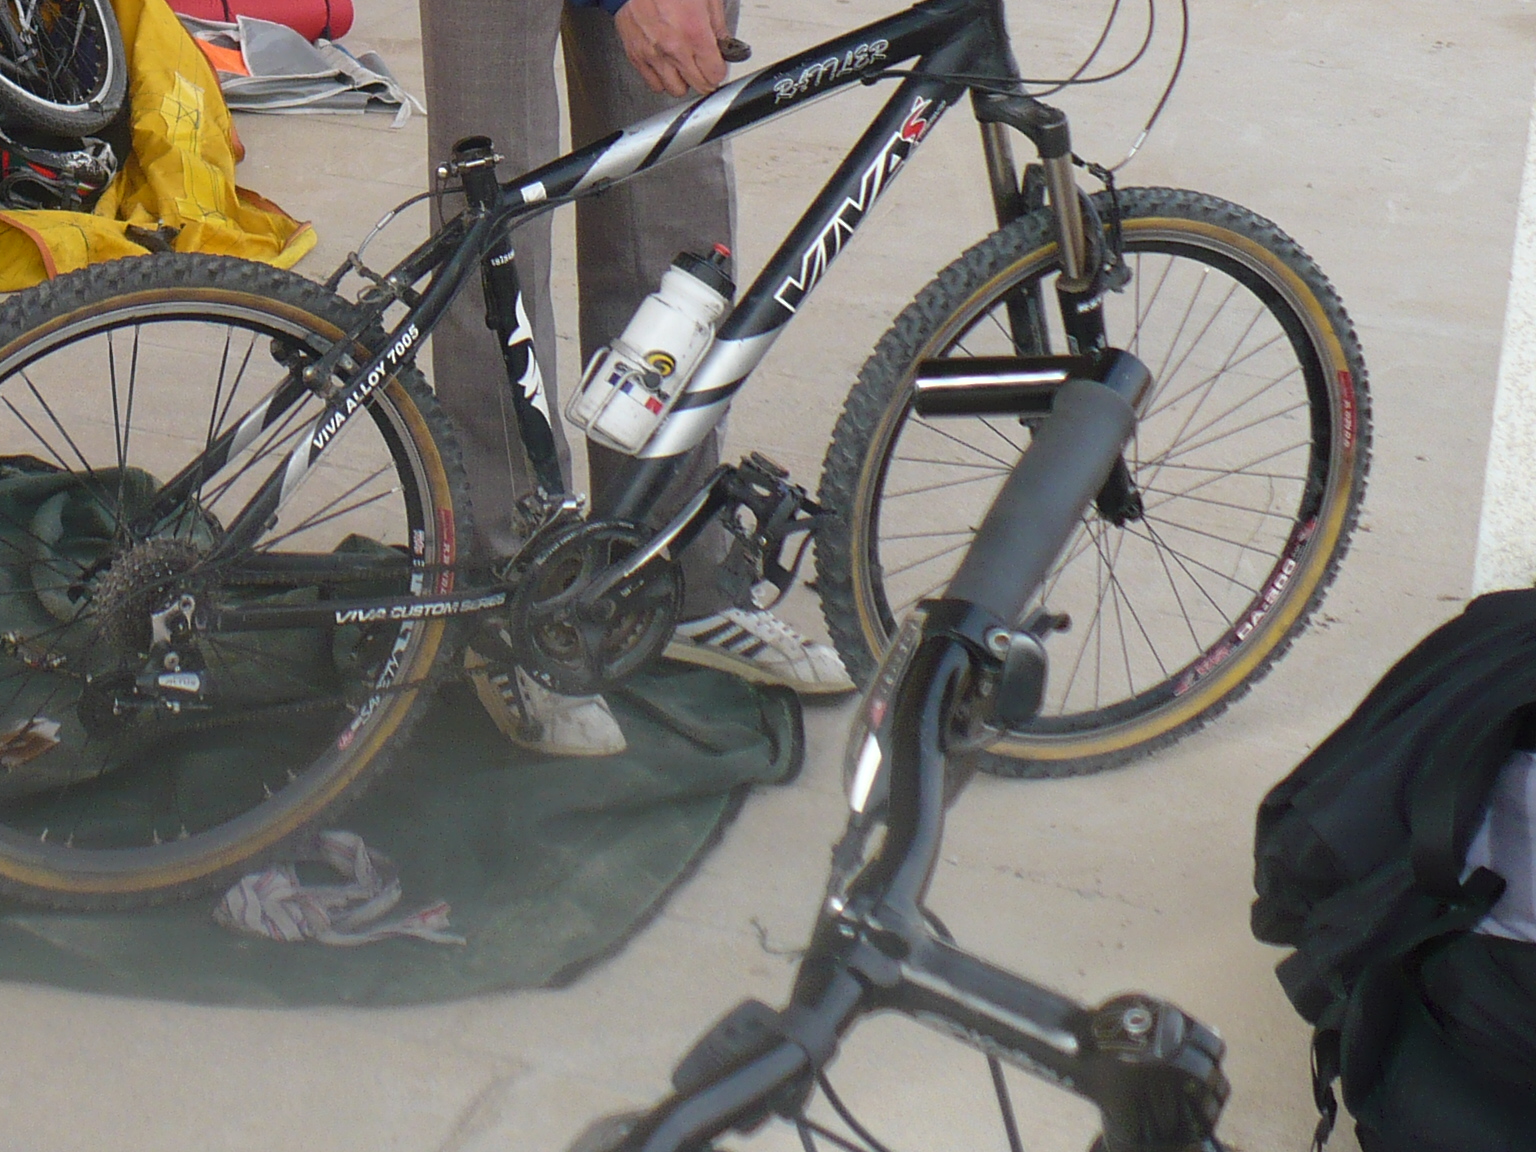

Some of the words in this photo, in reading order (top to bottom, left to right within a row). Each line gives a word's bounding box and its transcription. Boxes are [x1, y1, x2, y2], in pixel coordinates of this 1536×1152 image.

[772, 38, 890, 105] RATTLER
[312, 410, 346, 450] VIVA
[345, 359, 386, 415] ALLOY
[386, 322, 420, 365] 7005
[334, 607, 387, 625] VIVA
[390, 600, 460, 620] CUSTOM
